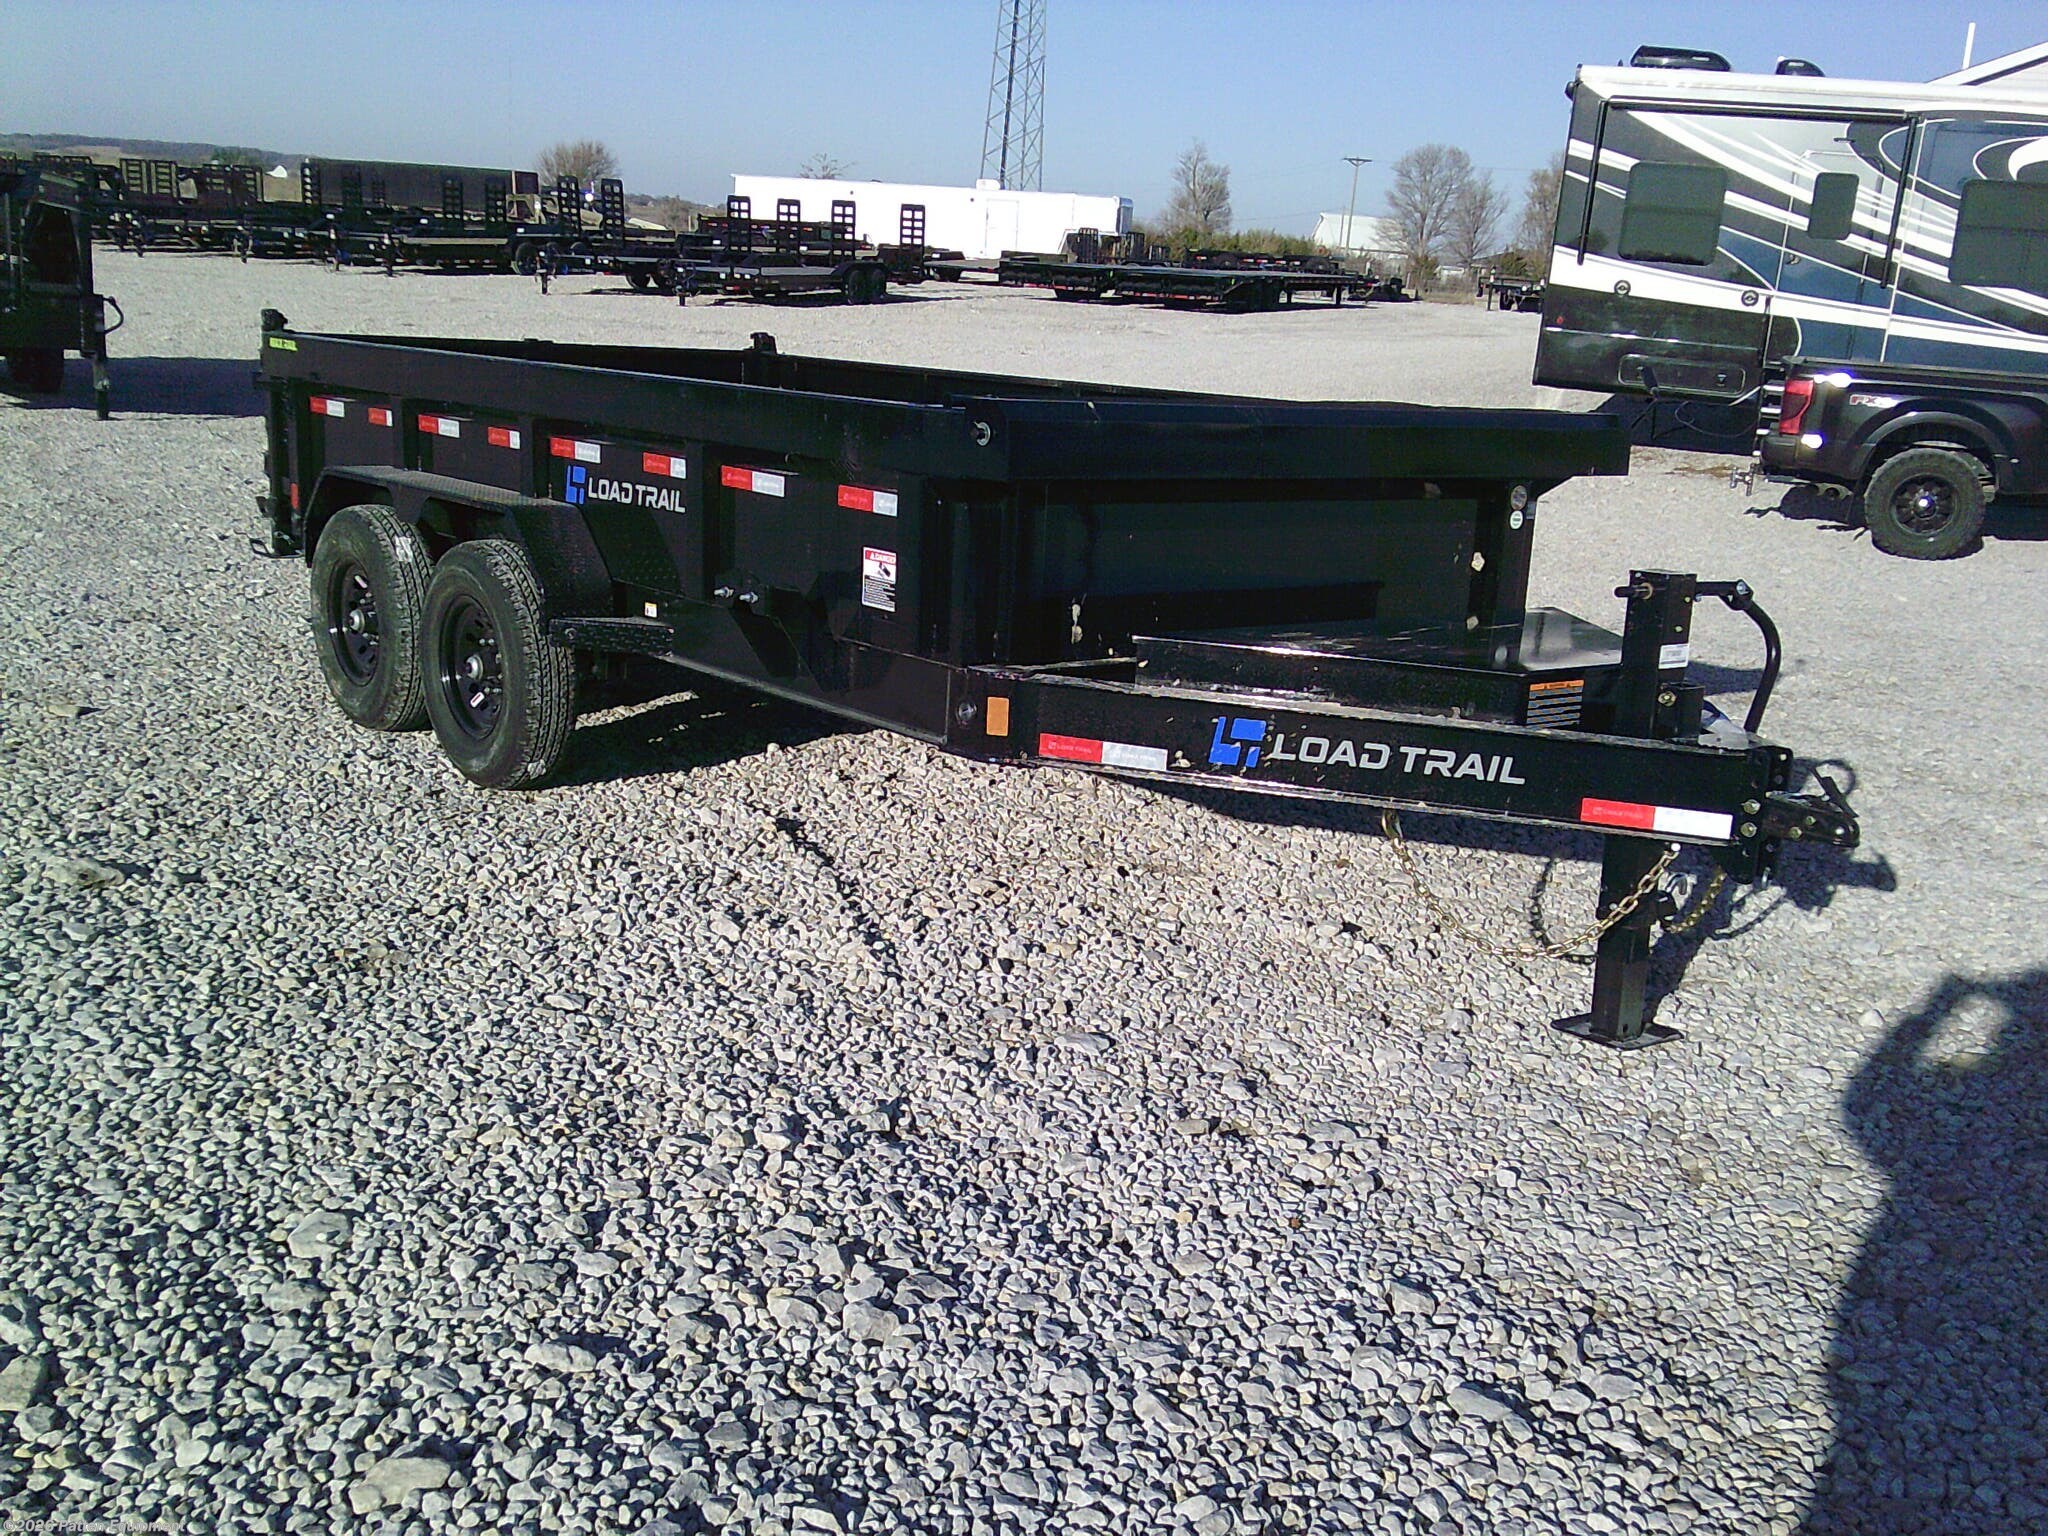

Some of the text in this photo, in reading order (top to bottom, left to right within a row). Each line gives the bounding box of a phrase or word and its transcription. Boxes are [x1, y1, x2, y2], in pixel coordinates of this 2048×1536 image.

[1849, 394, 1898, 409] FX
[588, 477, 686, 513] LOAD TRAIL
[1270, 733, 1526, 785] LOAD TRAIL
